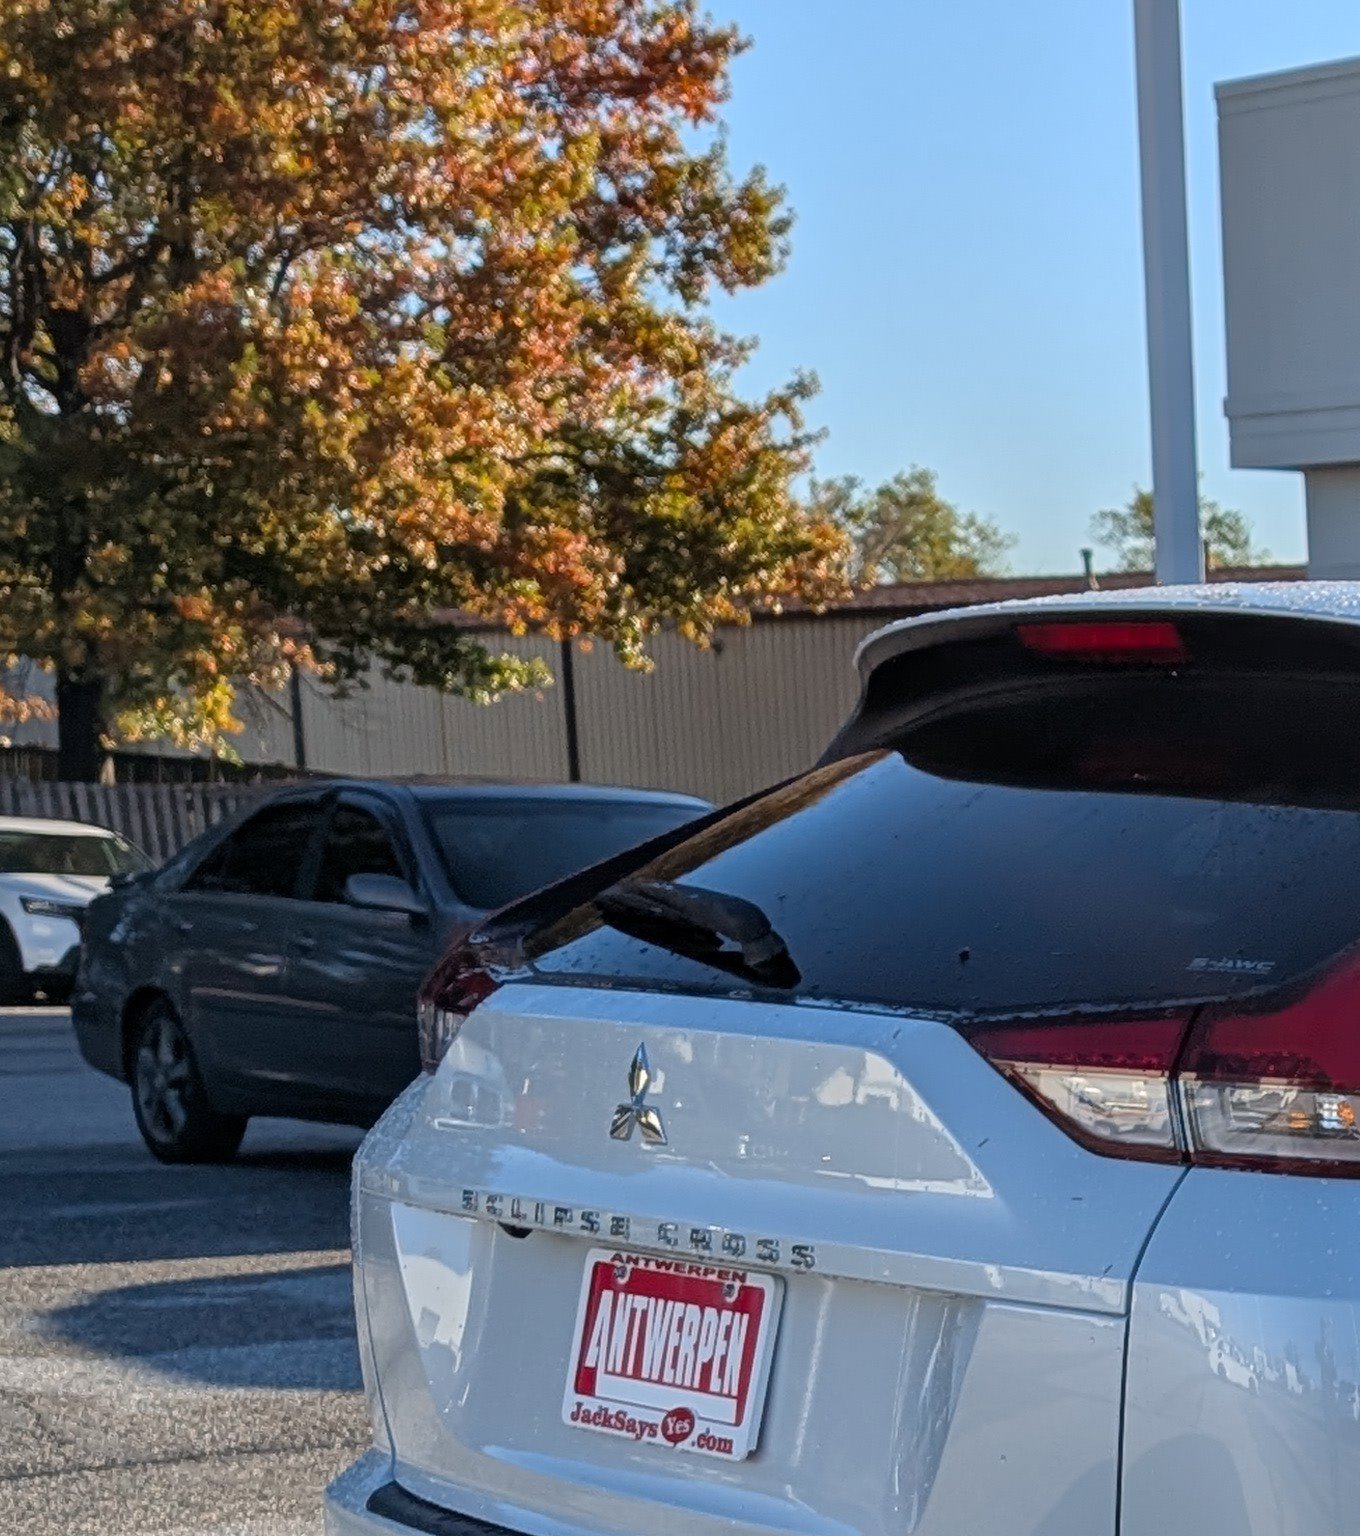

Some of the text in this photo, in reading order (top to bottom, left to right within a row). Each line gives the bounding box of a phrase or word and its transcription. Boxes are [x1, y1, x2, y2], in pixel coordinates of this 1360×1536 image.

[461, 1188, 817, 1270] ECLIPSE CROSS
[609, 1252, 747, 1284] ANTWERPEN
[584, 1289, 750, 1399] ANTWERPEN
